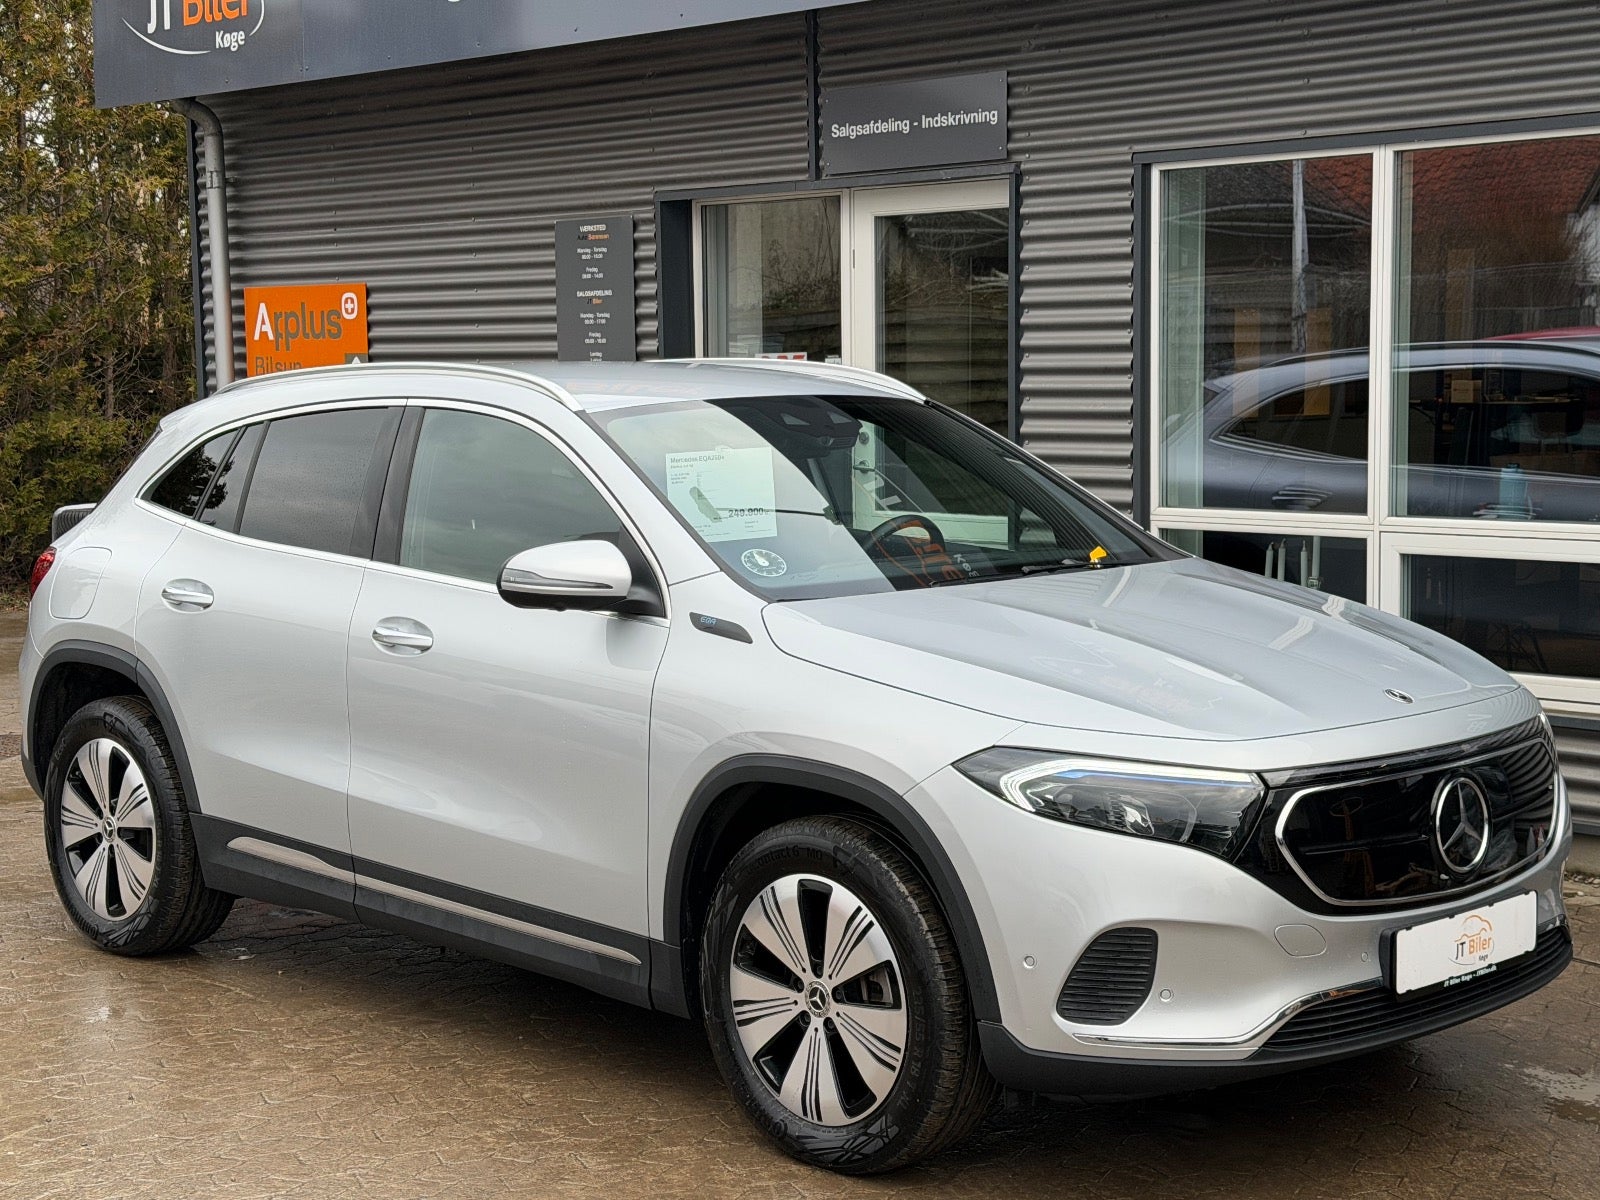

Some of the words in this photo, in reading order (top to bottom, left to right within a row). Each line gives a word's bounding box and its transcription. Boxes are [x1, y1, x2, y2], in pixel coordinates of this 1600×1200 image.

[215, 30, 245, 52] Køge
[831, 118, 910, 139] Salgsafdeling
[922, 108, 998, 129] Indskrivning
[700, 616, 716, 625] EQA
[1455, 941, 1466, 960] JT
[1469, 936, 1491, 954] Biler
